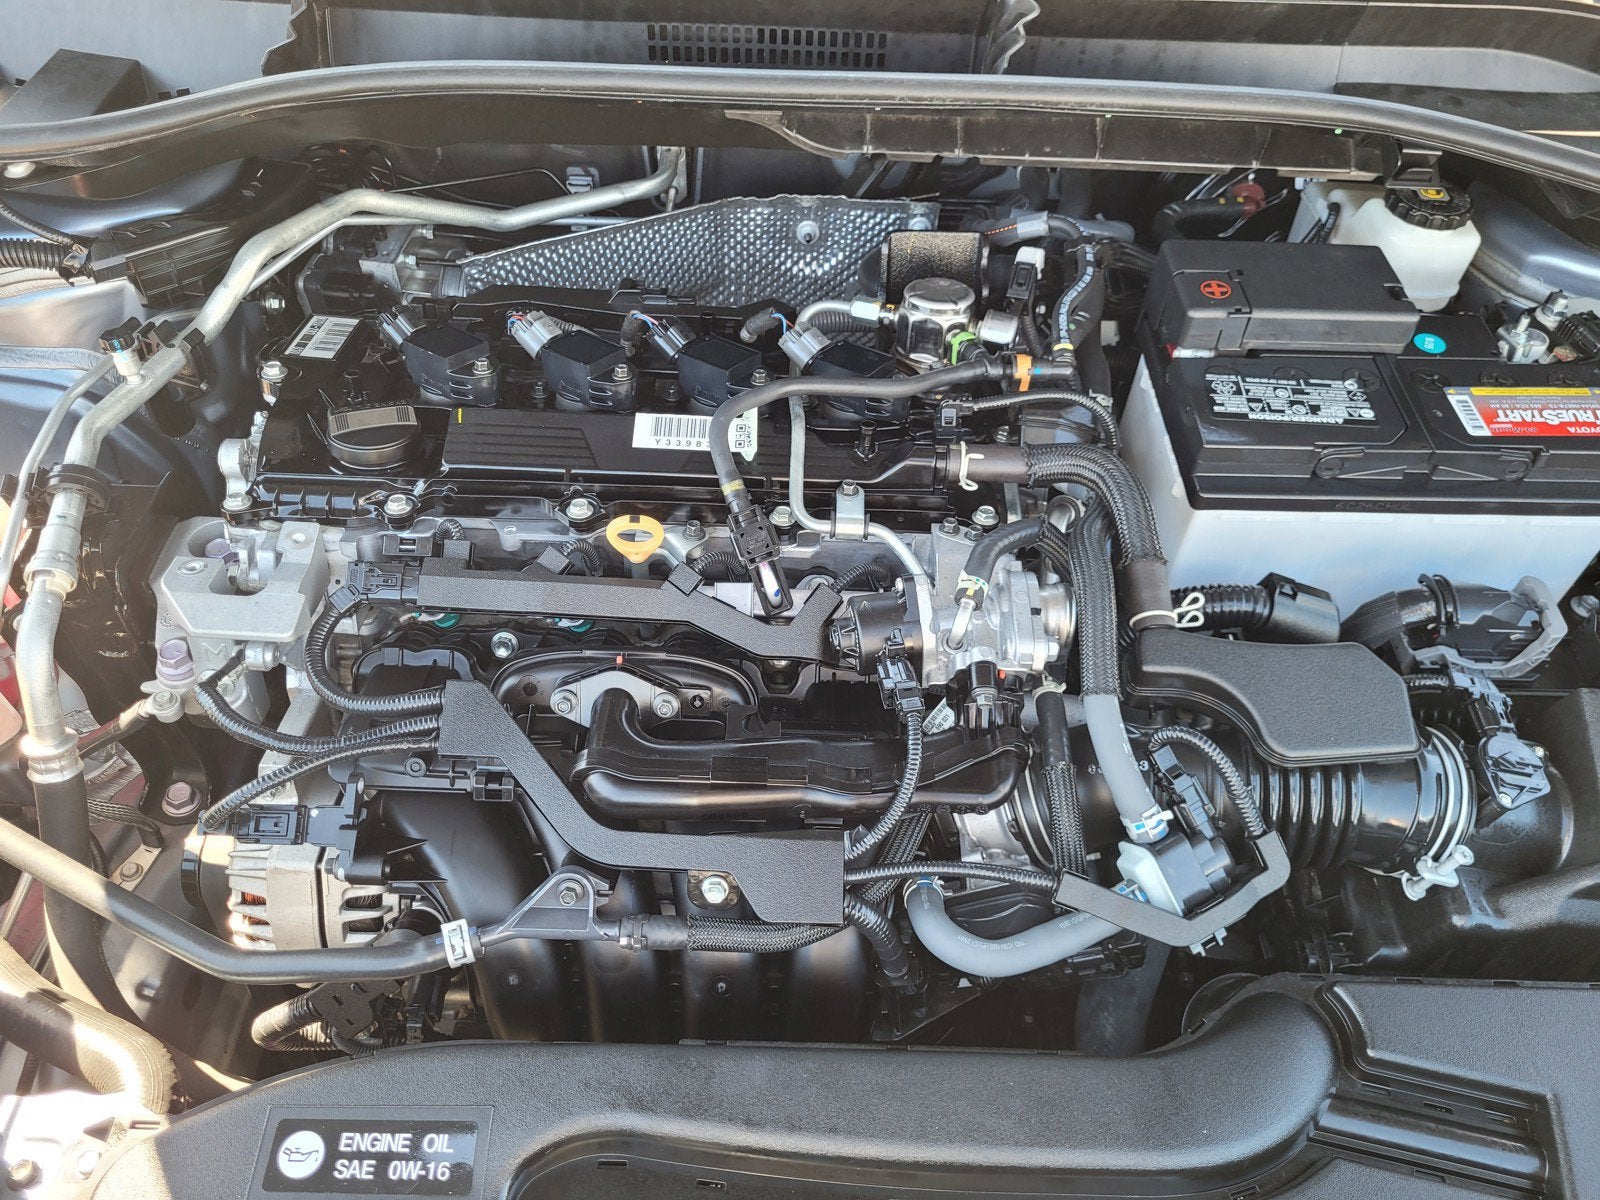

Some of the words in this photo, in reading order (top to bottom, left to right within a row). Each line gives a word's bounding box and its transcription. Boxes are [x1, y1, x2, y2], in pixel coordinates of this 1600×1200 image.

[1565, 426, 1600, 434] YOTA
[338, 1132, 412, 1152] ENGINE
[422, 1133, 453, 1152] OIL
[333, 1159, 376, 1179] SAE
[387, 1160, 451, 1181] 0W-16
